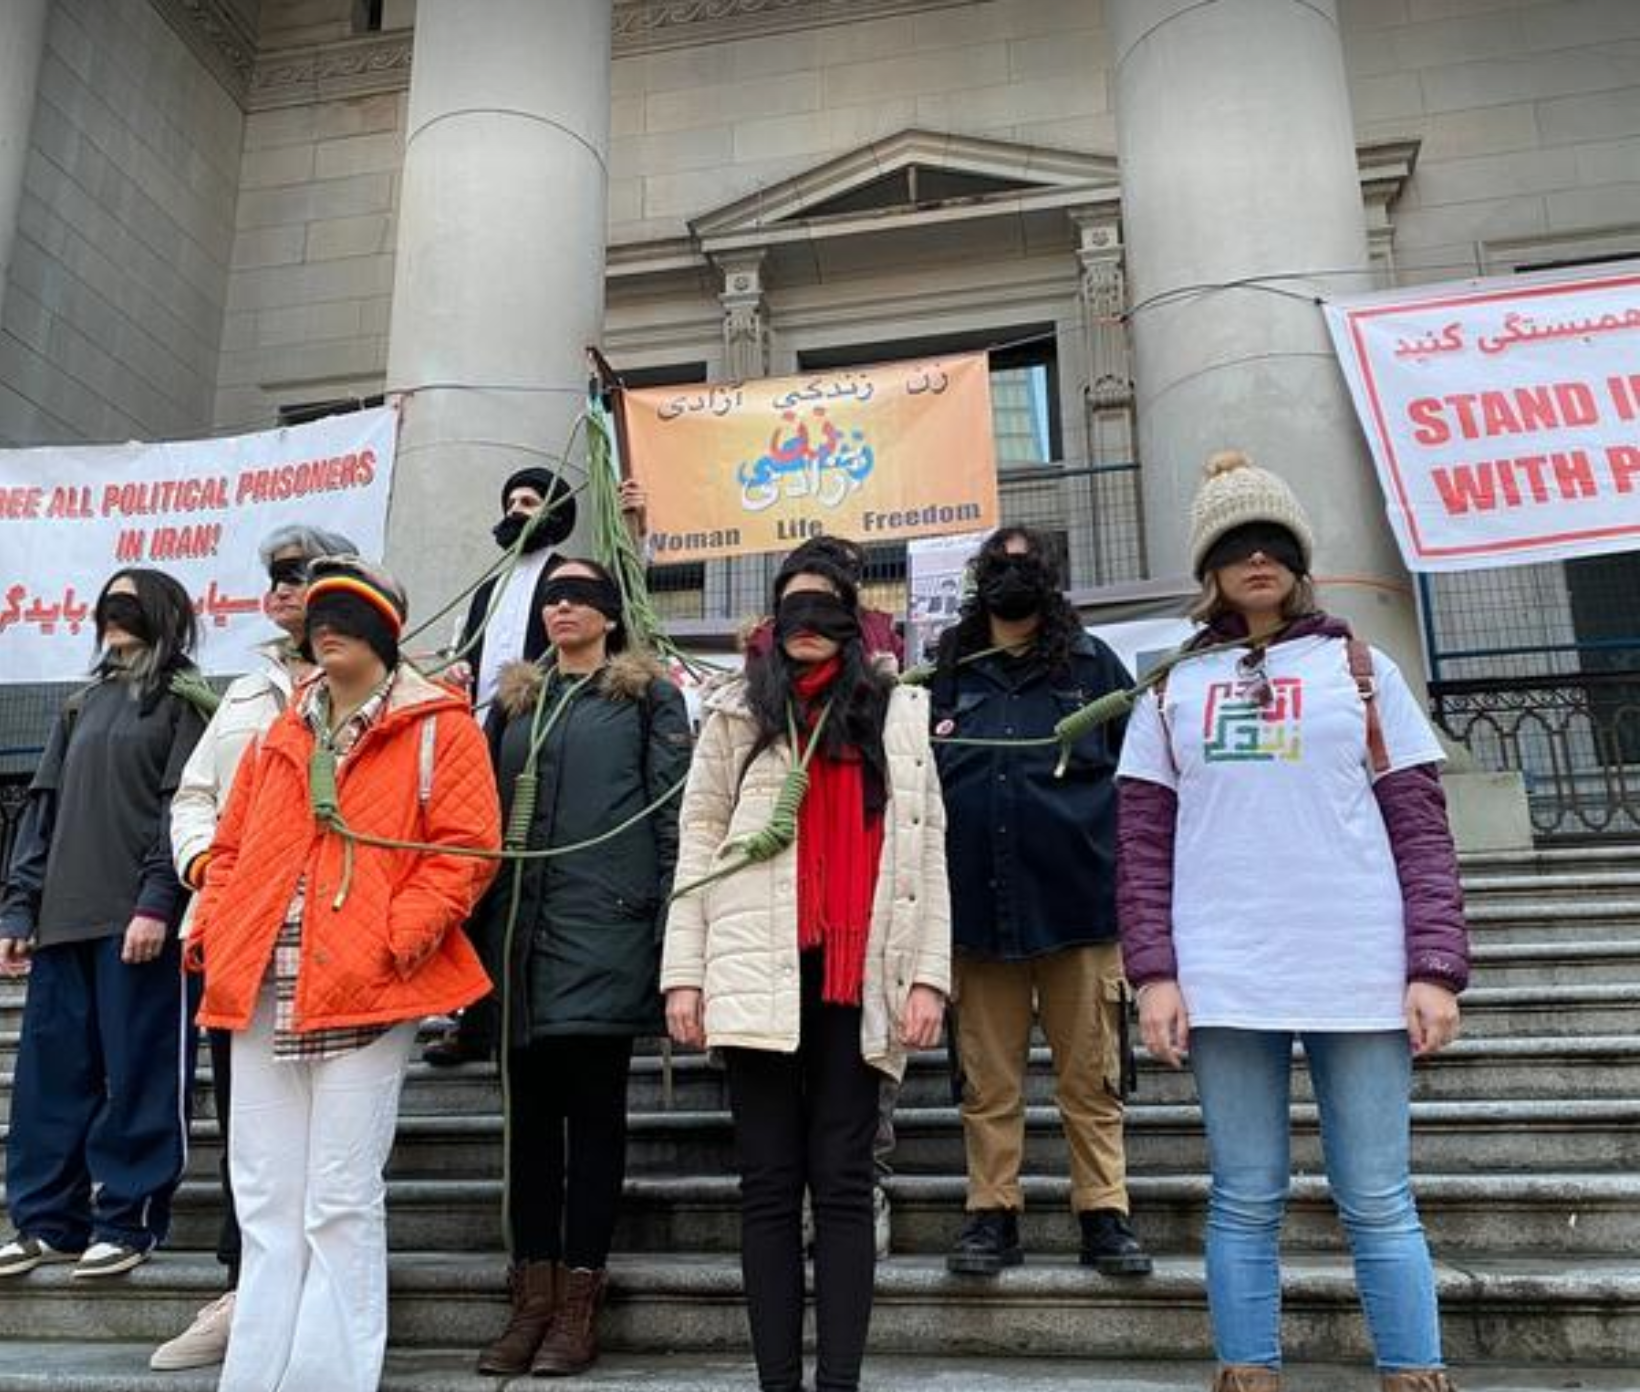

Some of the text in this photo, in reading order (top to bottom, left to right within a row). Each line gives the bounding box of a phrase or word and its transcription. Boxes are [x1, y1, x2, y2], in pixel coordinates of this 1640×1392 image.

[1408, 375, 1640, 446] STAND I
[48, 486, 93, 518] ALL
[101, 477, 228, 517] POLITICAL
[236, 450, 377, 506] PRISONERS
[1432, 451, 1598, 516] WITH
[115, 522, 221, 562] IN IRAN!
[777, 518, 823, 540] Life
[863, 502, 981, 531] Freedom
